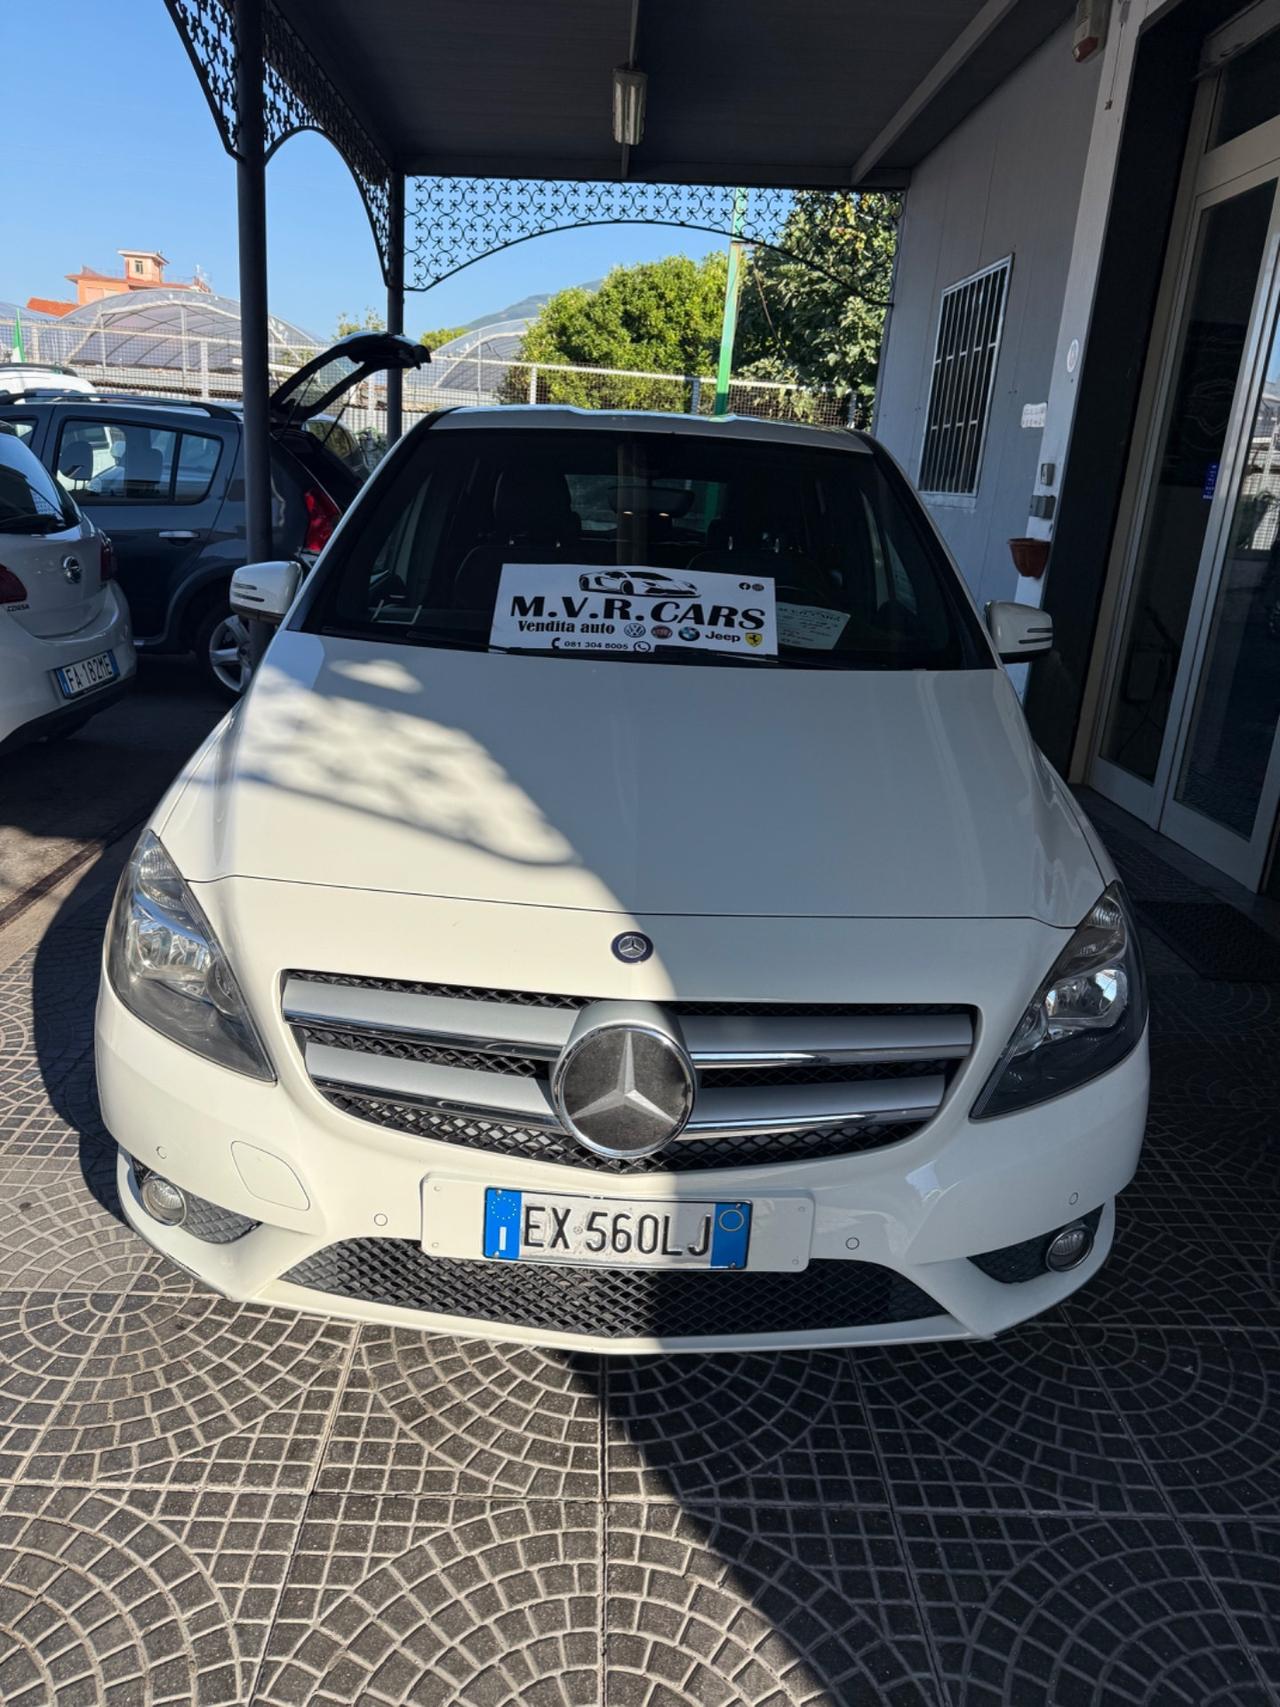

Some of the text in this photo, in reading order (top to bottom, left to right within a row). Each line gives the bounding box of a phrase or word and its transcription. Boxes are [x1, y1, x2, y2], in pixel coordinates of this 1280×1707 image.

[518, 620, 615, 635] Vendita auto
[705, 631, 741, 643] Jeep
[65, 667, 83, 691] FA
[523, 1205, 712, 1257] EX 560LJ
